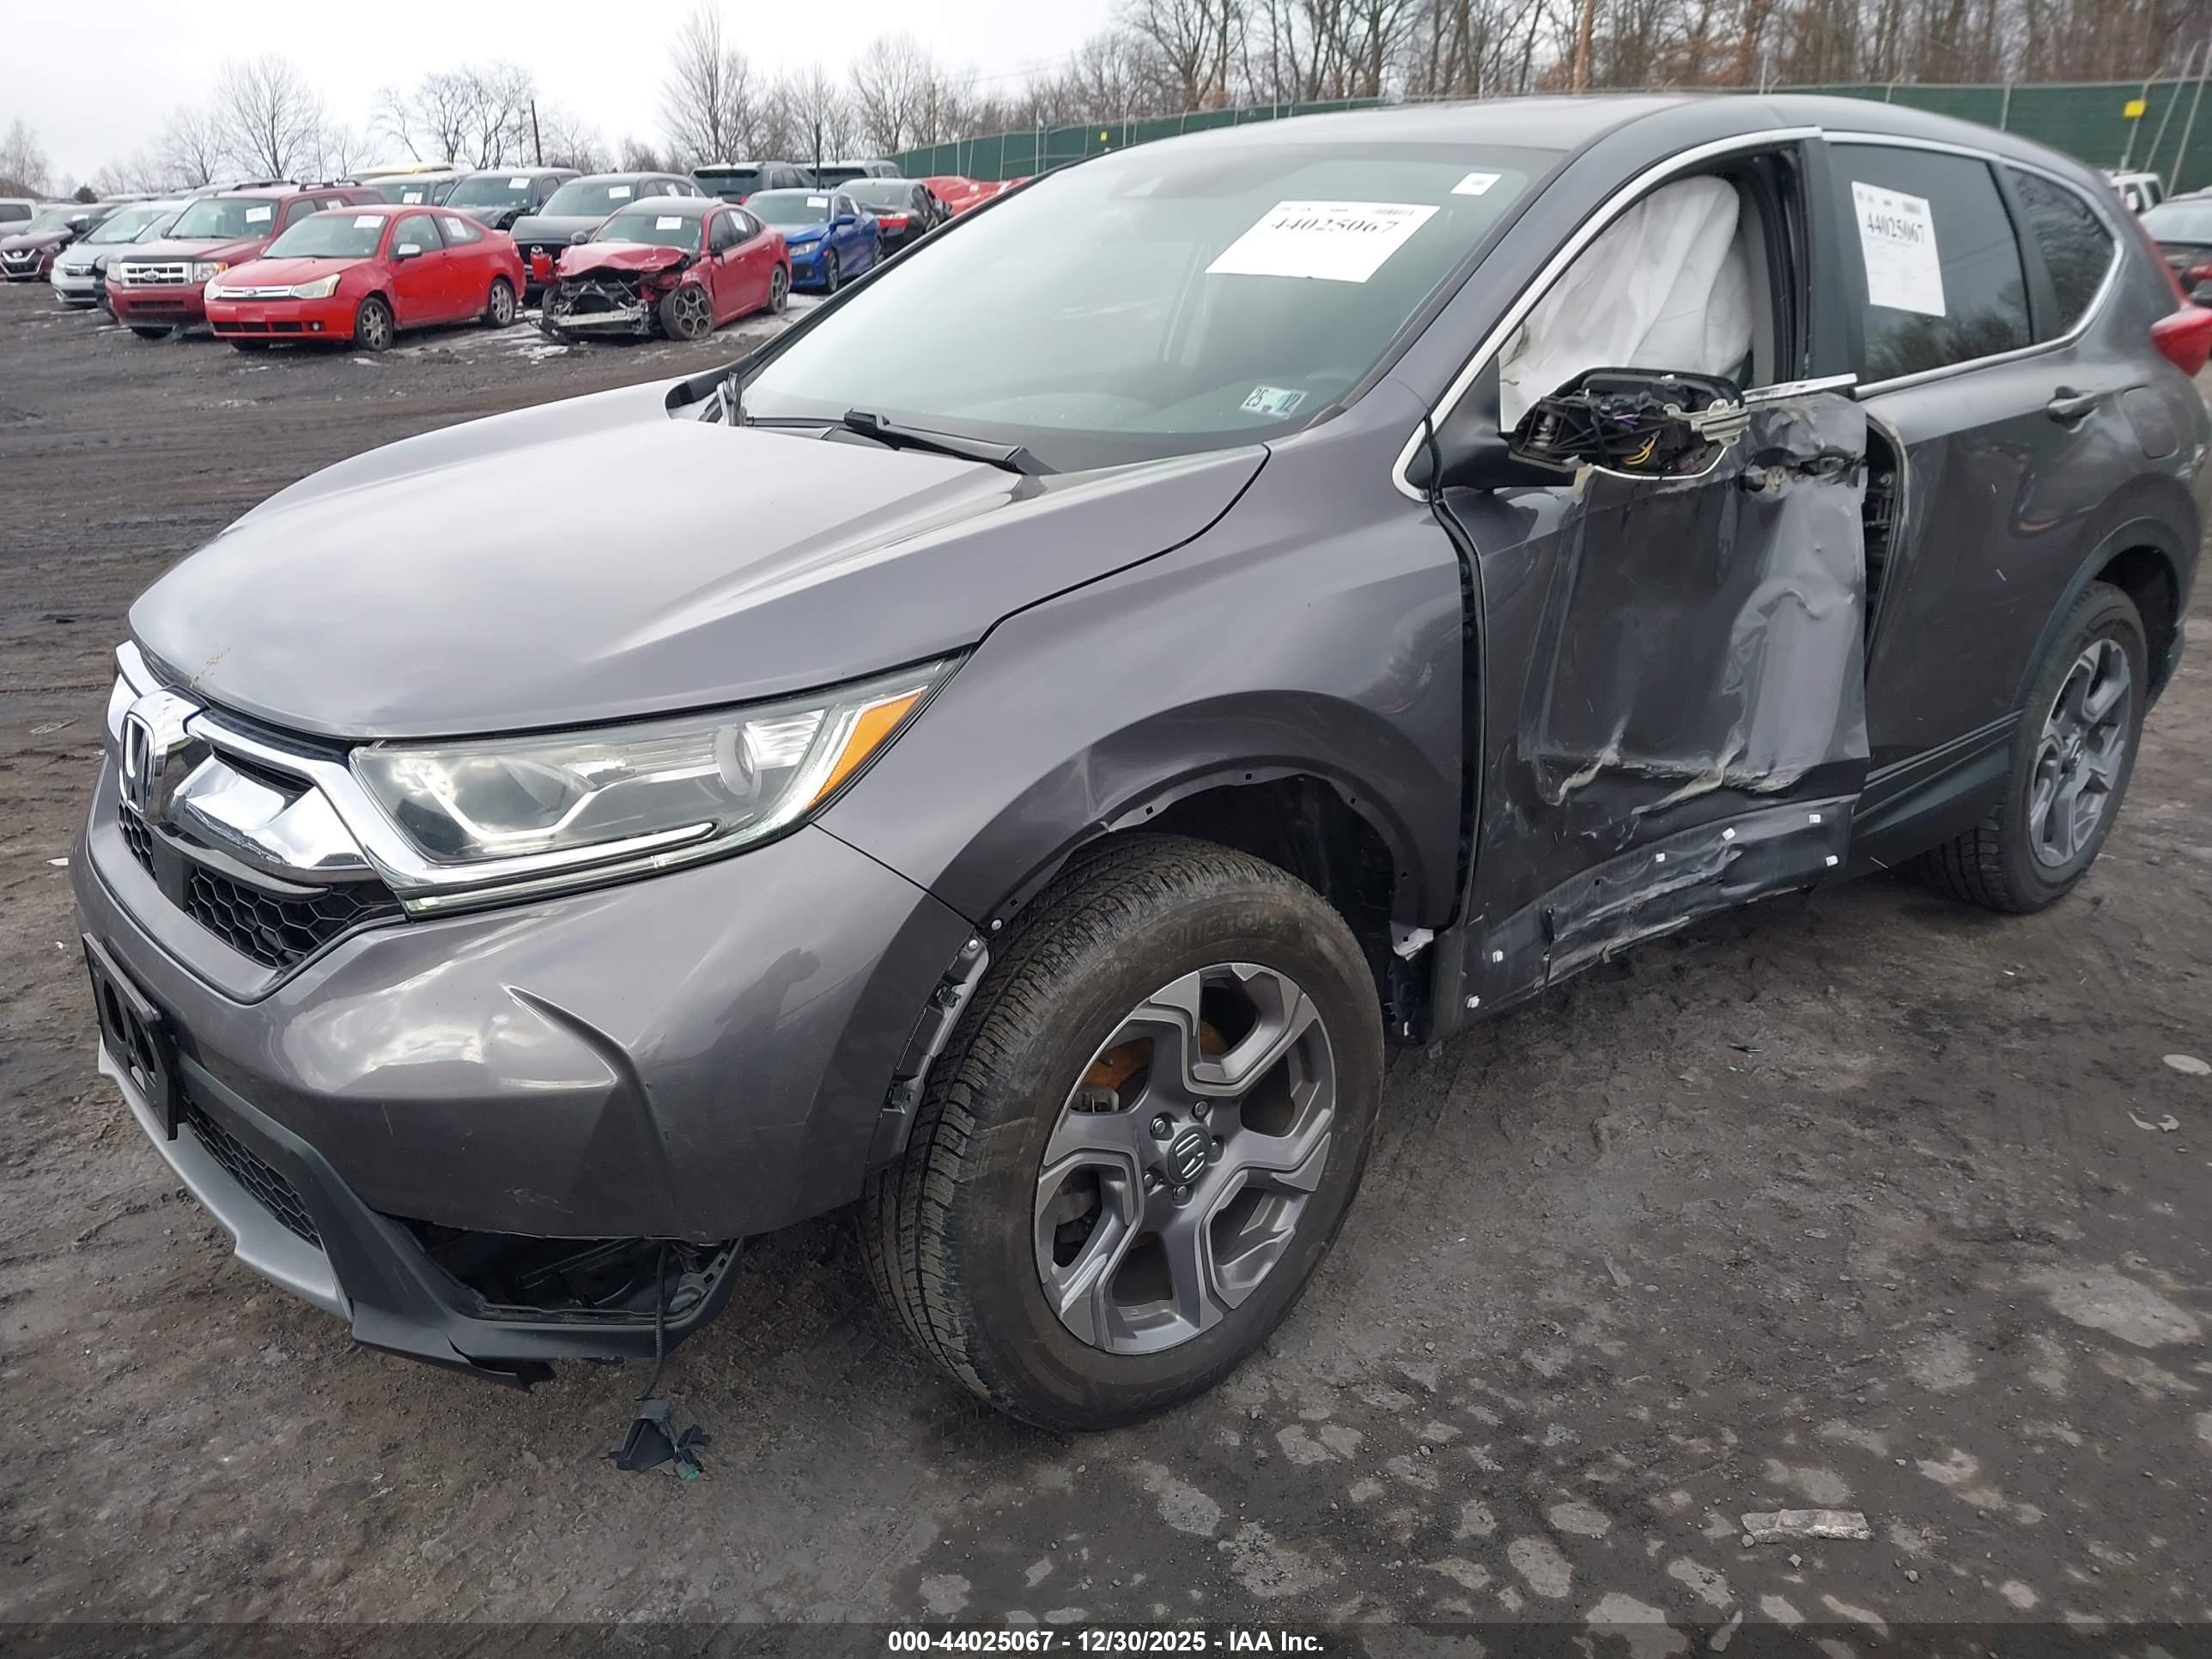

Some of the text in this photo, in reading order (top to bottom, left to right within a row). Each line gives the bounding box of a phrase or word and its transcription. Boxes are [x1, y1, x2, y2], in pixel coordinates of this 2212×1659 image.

[1271, 218, 1401, 234] 44025067
[1867, 212, 1924, 245] 44025067
[1244, 388, 1269, 408] 25
